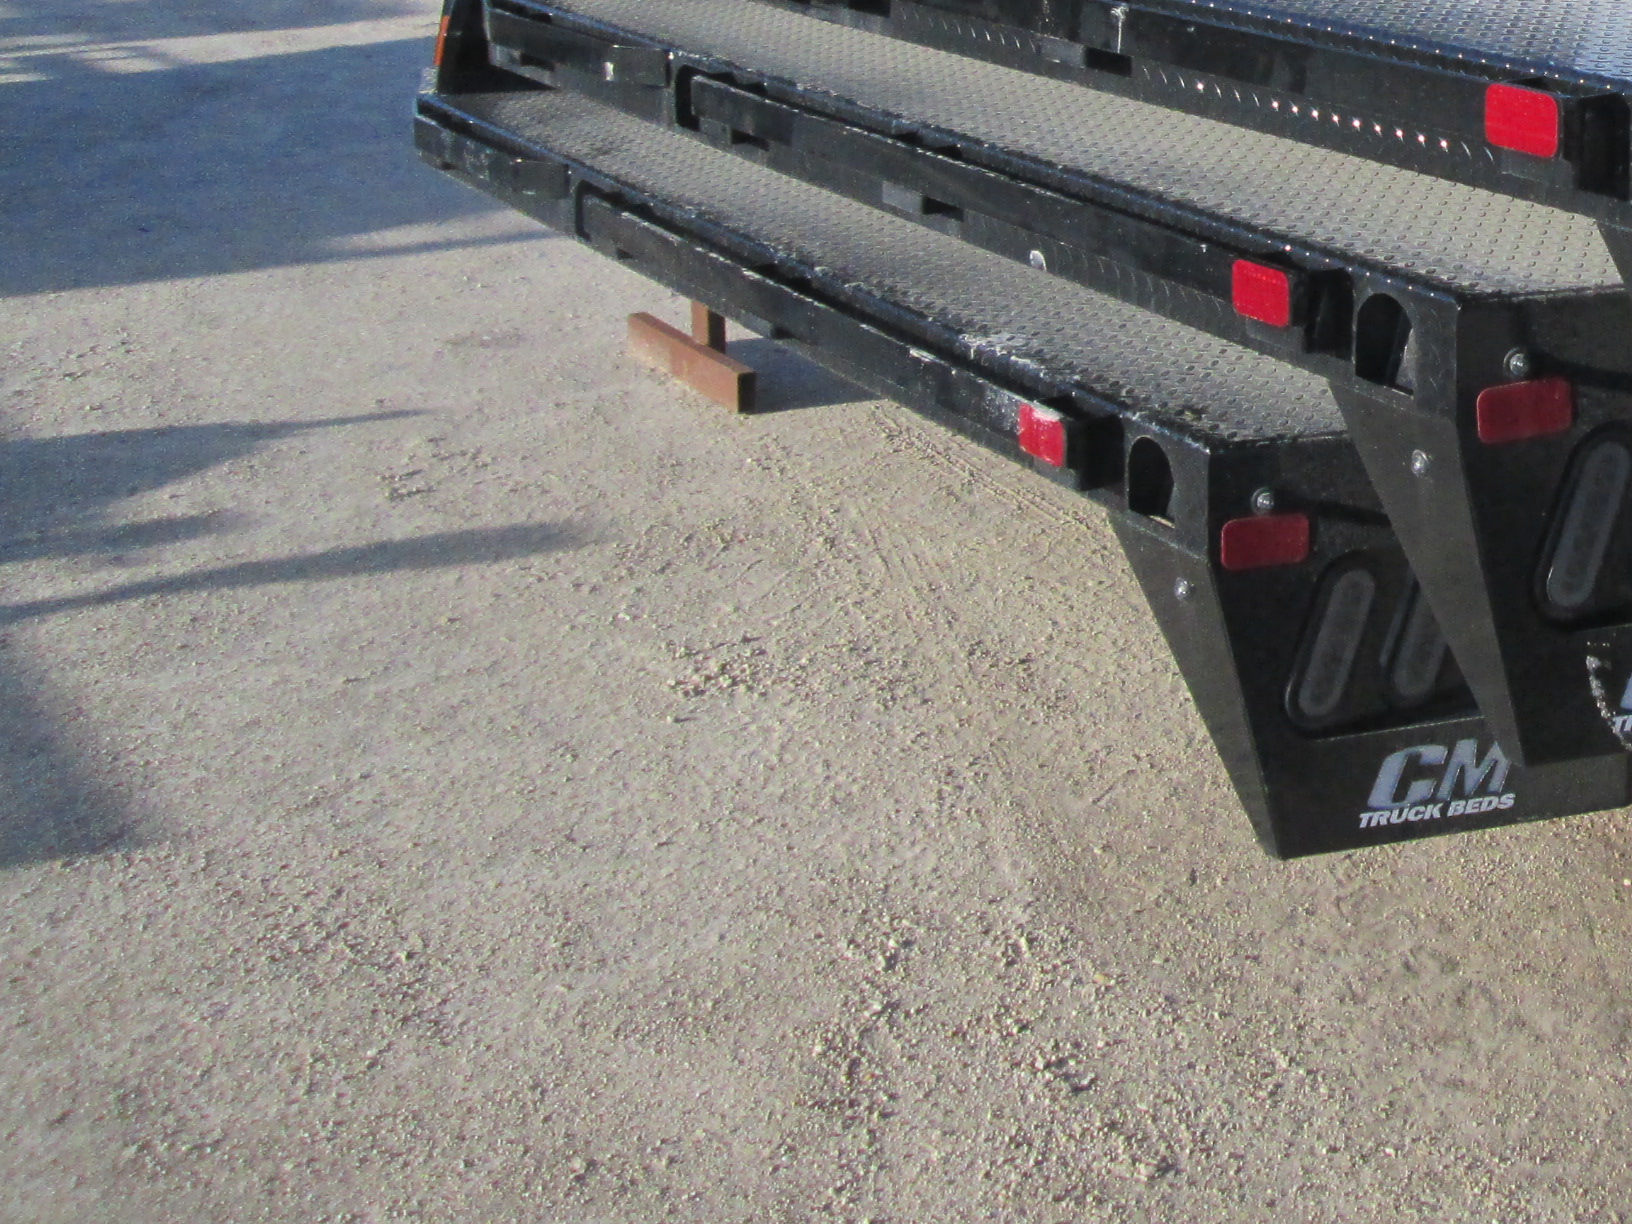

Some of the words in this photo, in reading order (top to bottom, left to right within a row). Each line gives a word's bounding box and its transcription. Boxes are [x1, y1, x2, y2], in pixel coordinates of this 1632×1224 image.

[1366, 738, 1512, 810] CM
[1359, 802, 1444, 829] TRUCK
[1446, 793, 1516, 817] BEDS
